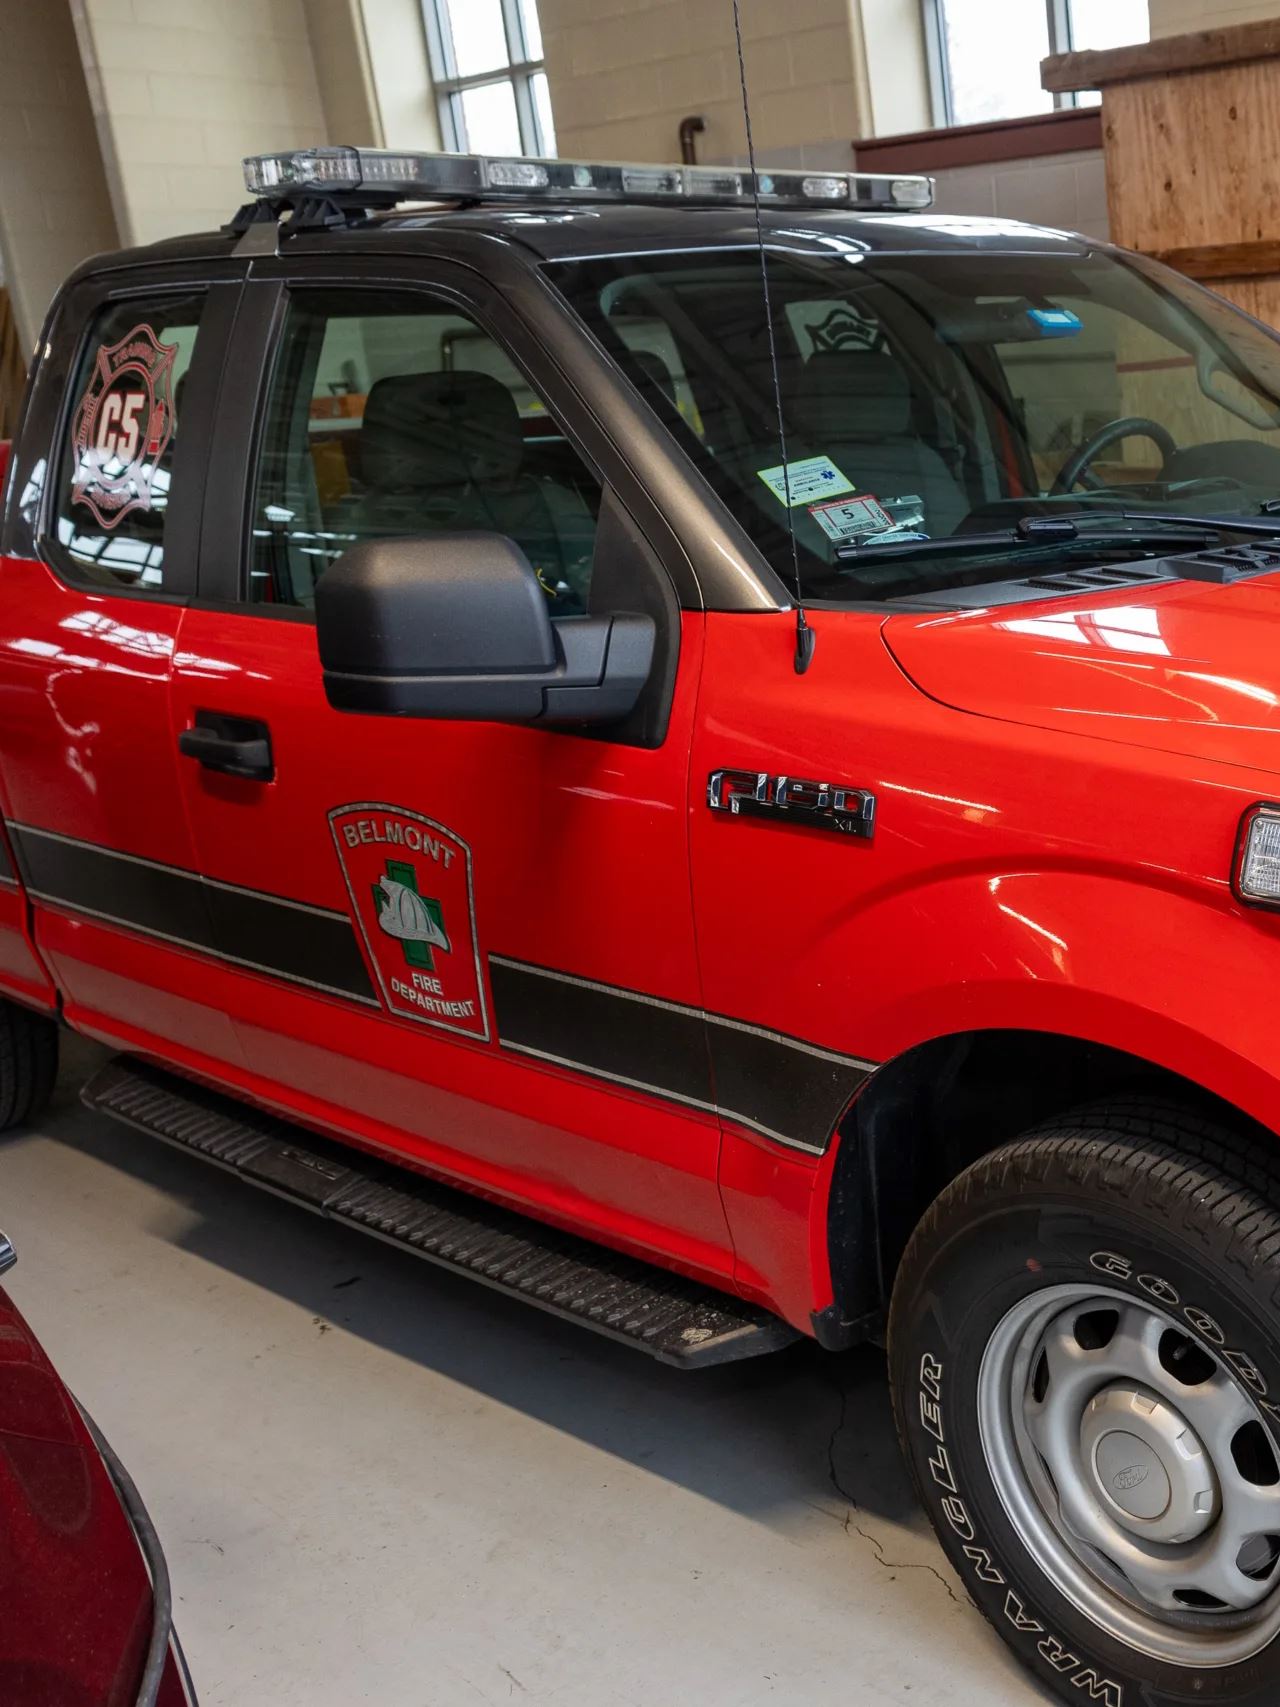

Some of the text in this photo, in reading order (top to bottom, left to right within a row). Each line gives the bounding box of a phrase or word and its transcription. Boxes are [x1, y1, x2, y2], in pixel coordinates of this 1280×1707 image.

[96, 392, 145, 465] C5
[841, 508, 855, 520] 5
[343, 820, 456, 868] BELMONT
[391, 977, 476, 1018] DEPARTMENT
[412, 972, 444, 995] FIRE
[920, 1353, 1121, 1707] WRANGLER
